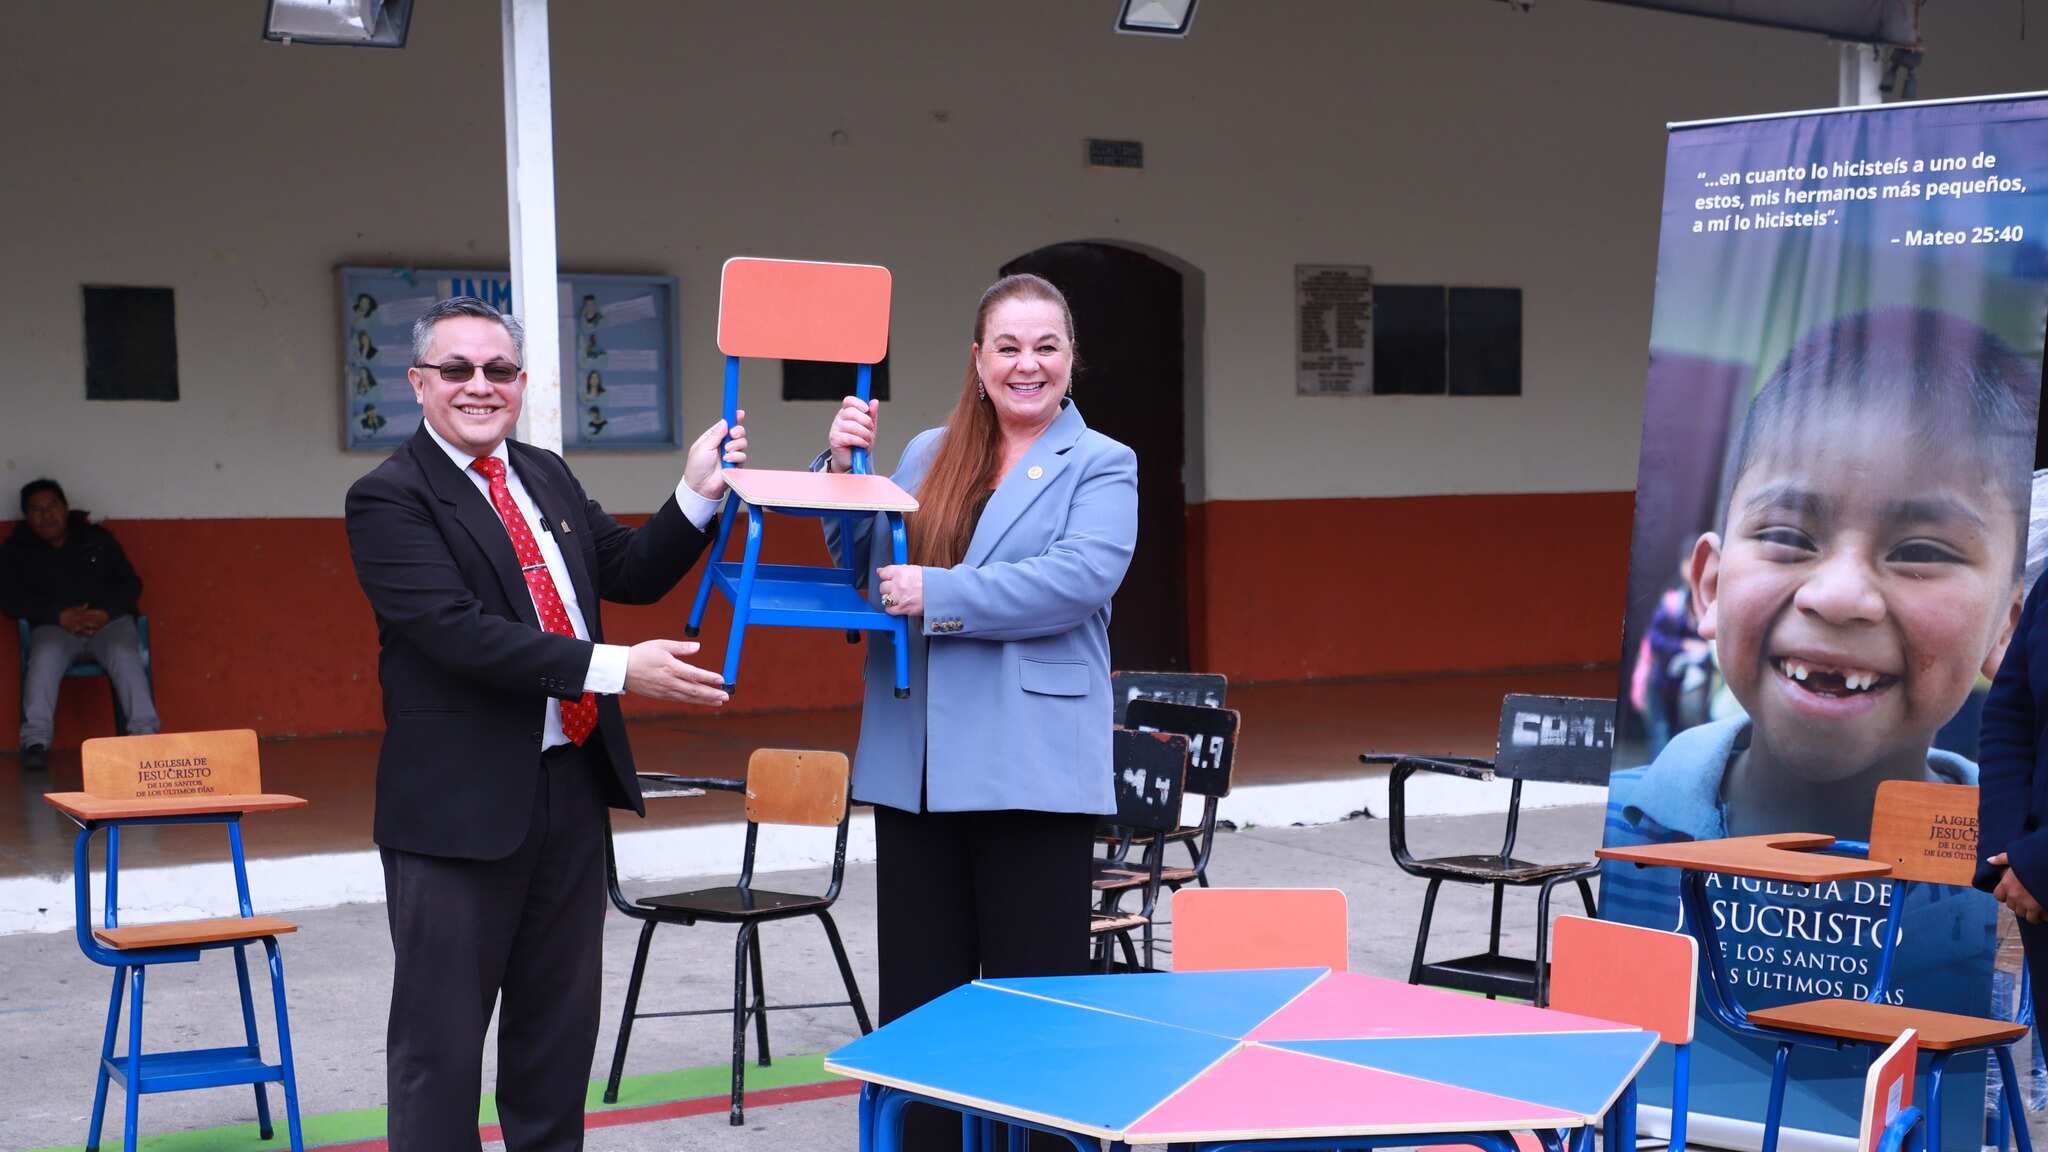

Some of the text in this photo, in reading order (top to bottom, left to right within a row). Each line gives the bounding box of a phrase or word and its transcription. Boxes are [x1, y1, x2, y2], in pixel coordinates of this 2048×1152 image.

[1745, 165, 1806, 184] cuanto
[1811, 163, 1828, 180] lo
[1832, 157, 1909, 178] hicisteís
[1912, 159, 1924, 173] a
[1930, 156, 1967, 172] uno
[1971, 152, 1996, 169] de
[1695, 175, 2027, 210] estos, mis hermanos más pequeños,
[1692, 220, 1703, 233] a
[1707, 214, 1731, 232] mí
[1734, 214, 1750, 230] lo
[1905, 229, 1967, 246] Mateo
[1971, 225, 2024, 243] 25:40
[137, 767, 211, 784] JESUCRISTO
[139, 757, 208, 769] LA IGLESIA DE
[1935, 815, 1978, 827] LA IGLE
[1705, 872, 1722, 888] A
[1854, 881, 1892, 906] DE
[1674, 896, 1903, 949] JSUCRISTO
[1737, 943, 1775, 963] LOS
[1782, 949, 1868, 975] SANTOS
[1747, 967, 1844, 998] ÚLTIMOS
